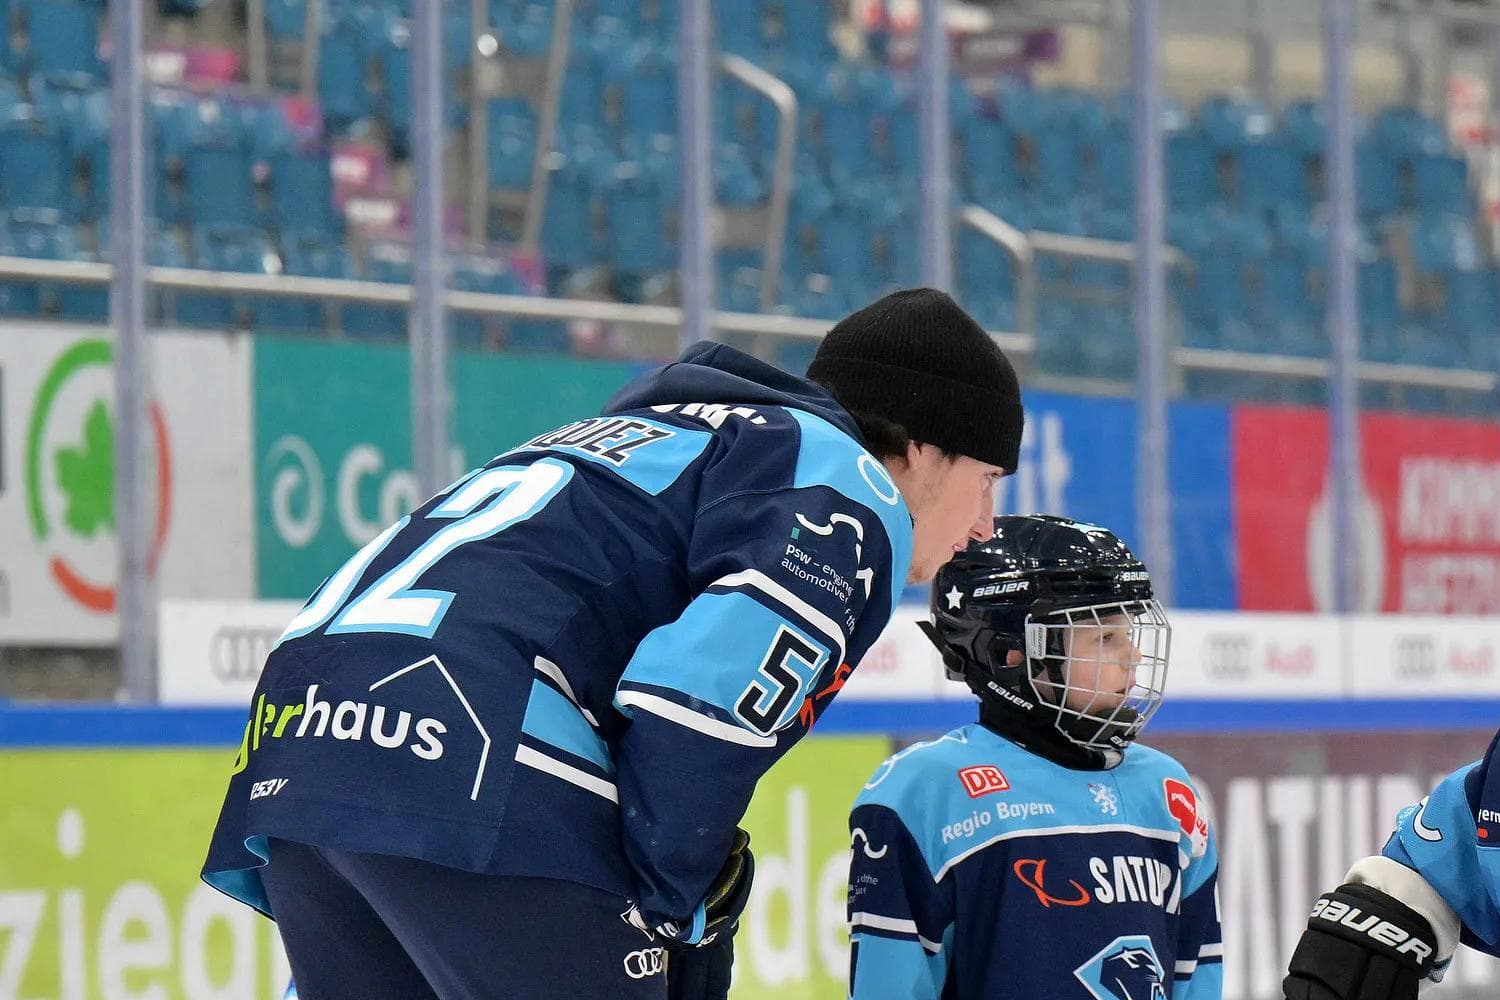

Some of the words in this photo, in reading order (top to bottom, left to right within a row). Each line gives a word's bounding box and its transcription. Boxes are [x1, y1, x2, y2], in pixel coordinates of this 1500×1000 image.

[785, 544, 812, 564] psw
[973, 580, 1030, 598] BAUER
[987, 680, 1034, 711] BAUER
[962, 767, 1006, 793] DB
[941, 811, 992, 844] Regio
[996, 801, 1056, 820] Bayern
[1310, 897, 1433, 967] BAUER
